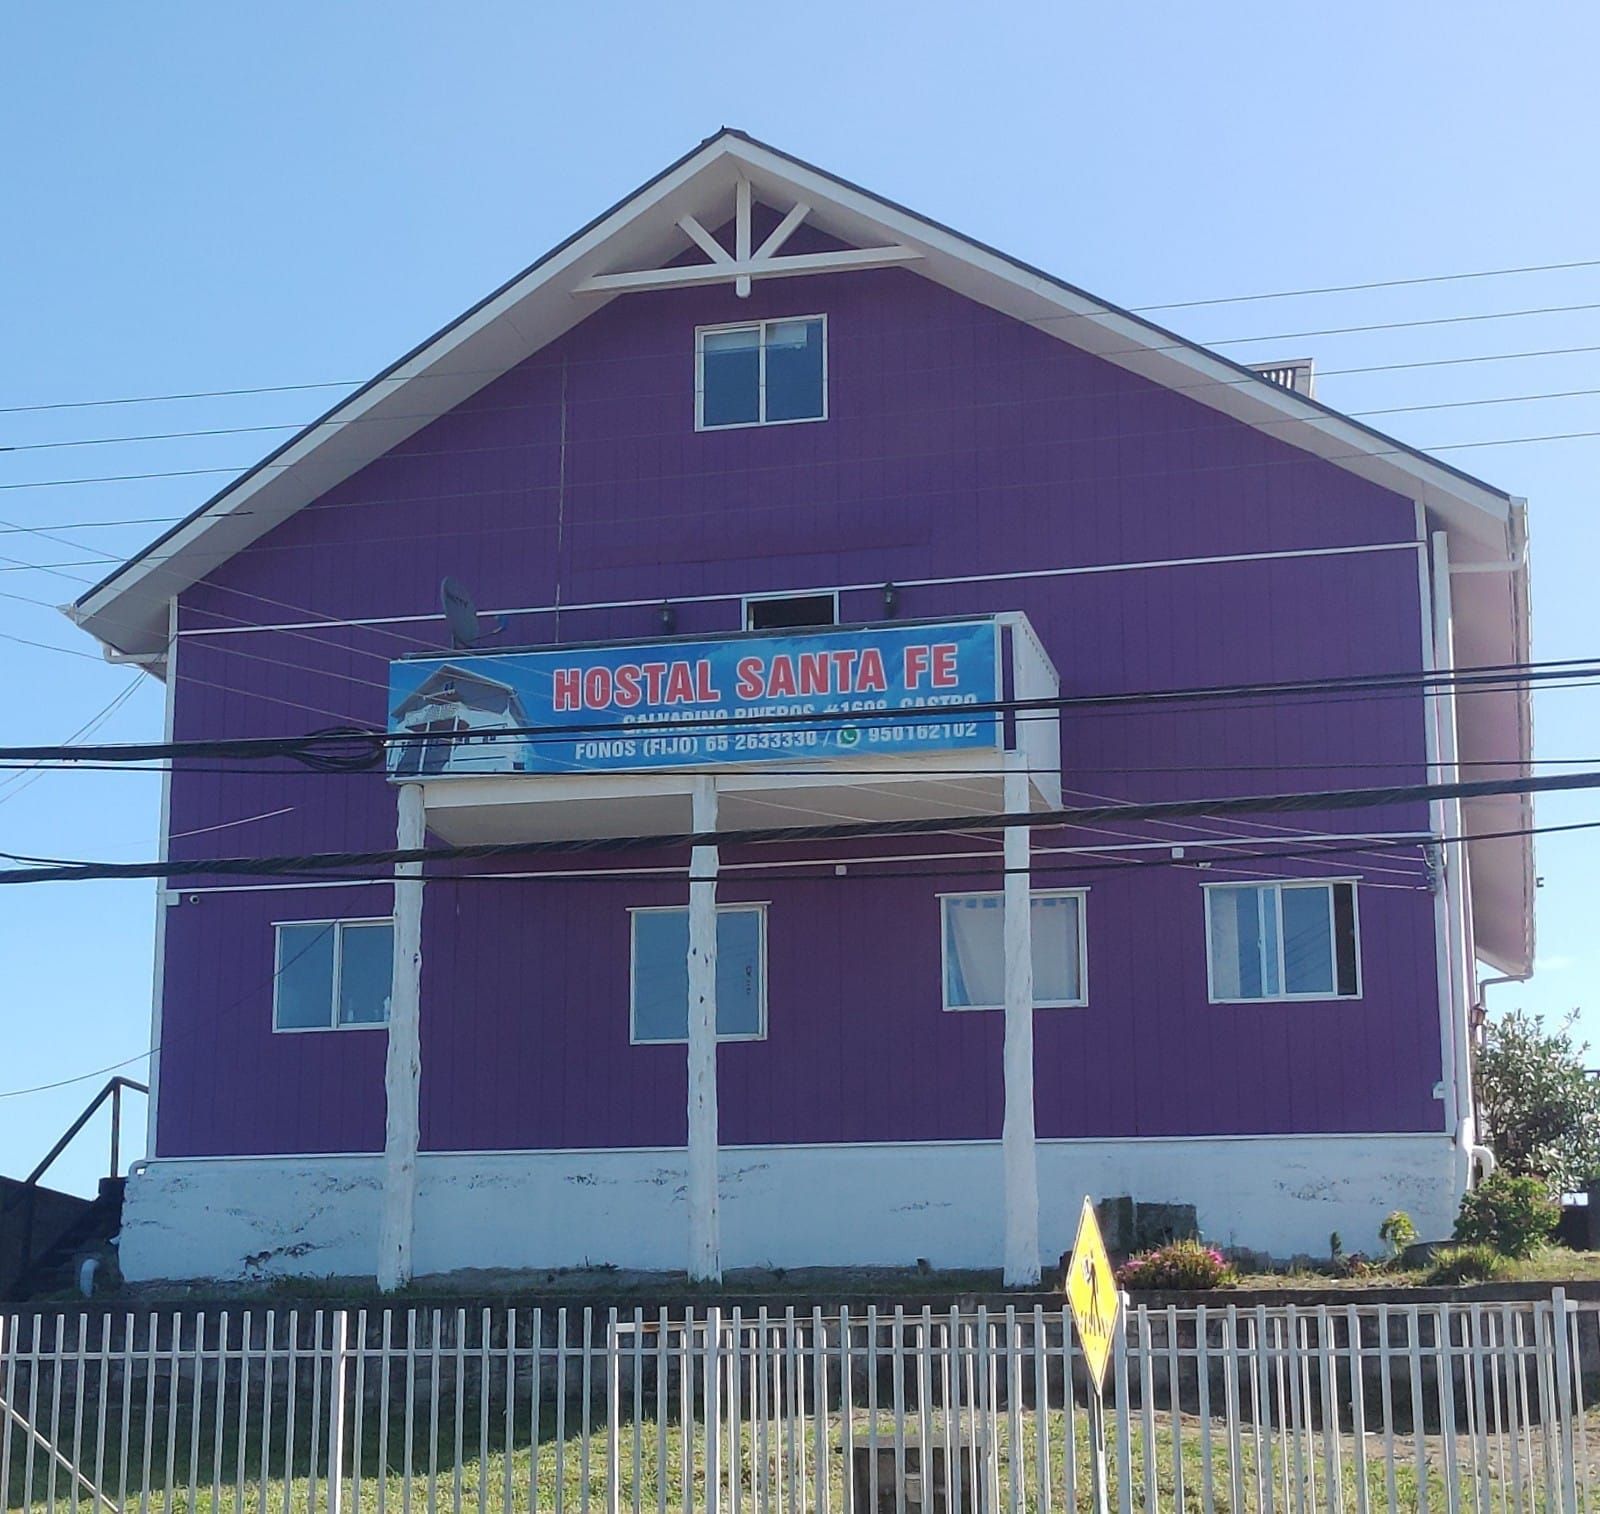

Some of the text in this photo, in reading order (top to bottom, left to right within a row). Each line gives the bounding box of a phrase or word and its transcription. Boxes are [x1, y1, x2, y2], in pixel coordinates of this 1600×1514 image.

[553, 643, 959, 712] HOSTAL SANTA FE
[575, 740, 636, 760] FONOS
[643, 736, 698, 757] (FIJO)
[706, 735, 729, 752] 65
[735, 731, 816, 751] 2633330
[868, 722, 977, 742] 950162102
